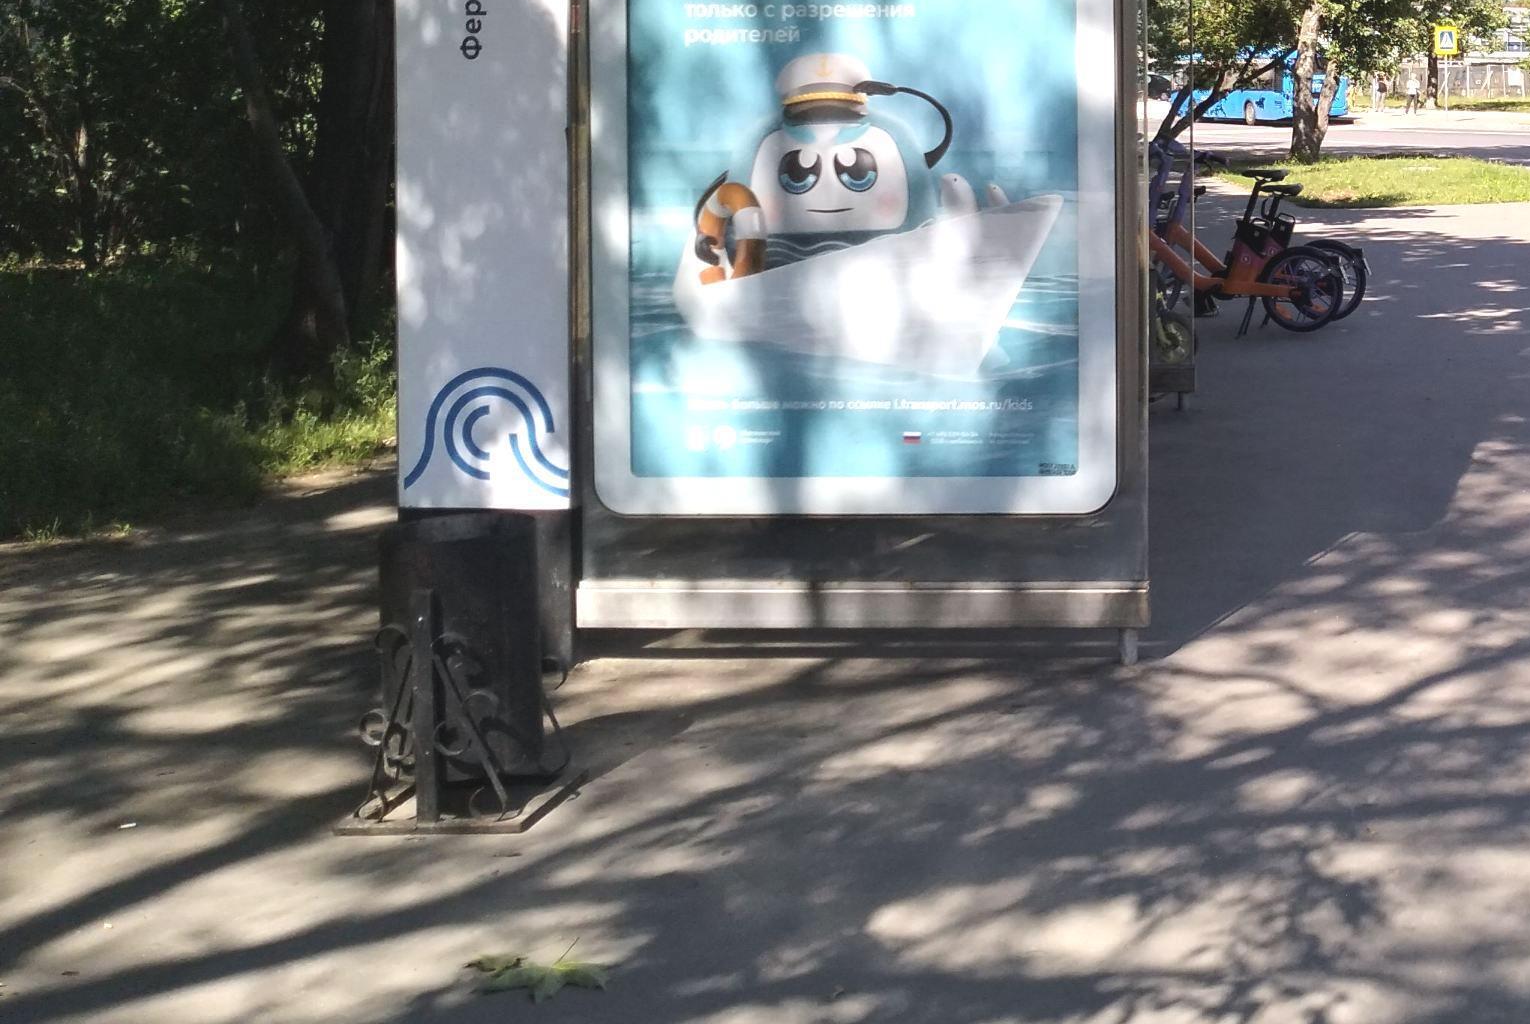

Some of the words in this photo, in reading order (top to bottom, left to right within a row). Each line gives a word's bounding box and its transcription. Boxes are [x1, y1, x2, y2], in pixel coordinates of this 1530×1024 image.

[684, 3, 757, 18] только
[764, 3, 775, 18] с
[781, 3, 916, 21] разрешения
[684, 25, 800, 47] родителей
